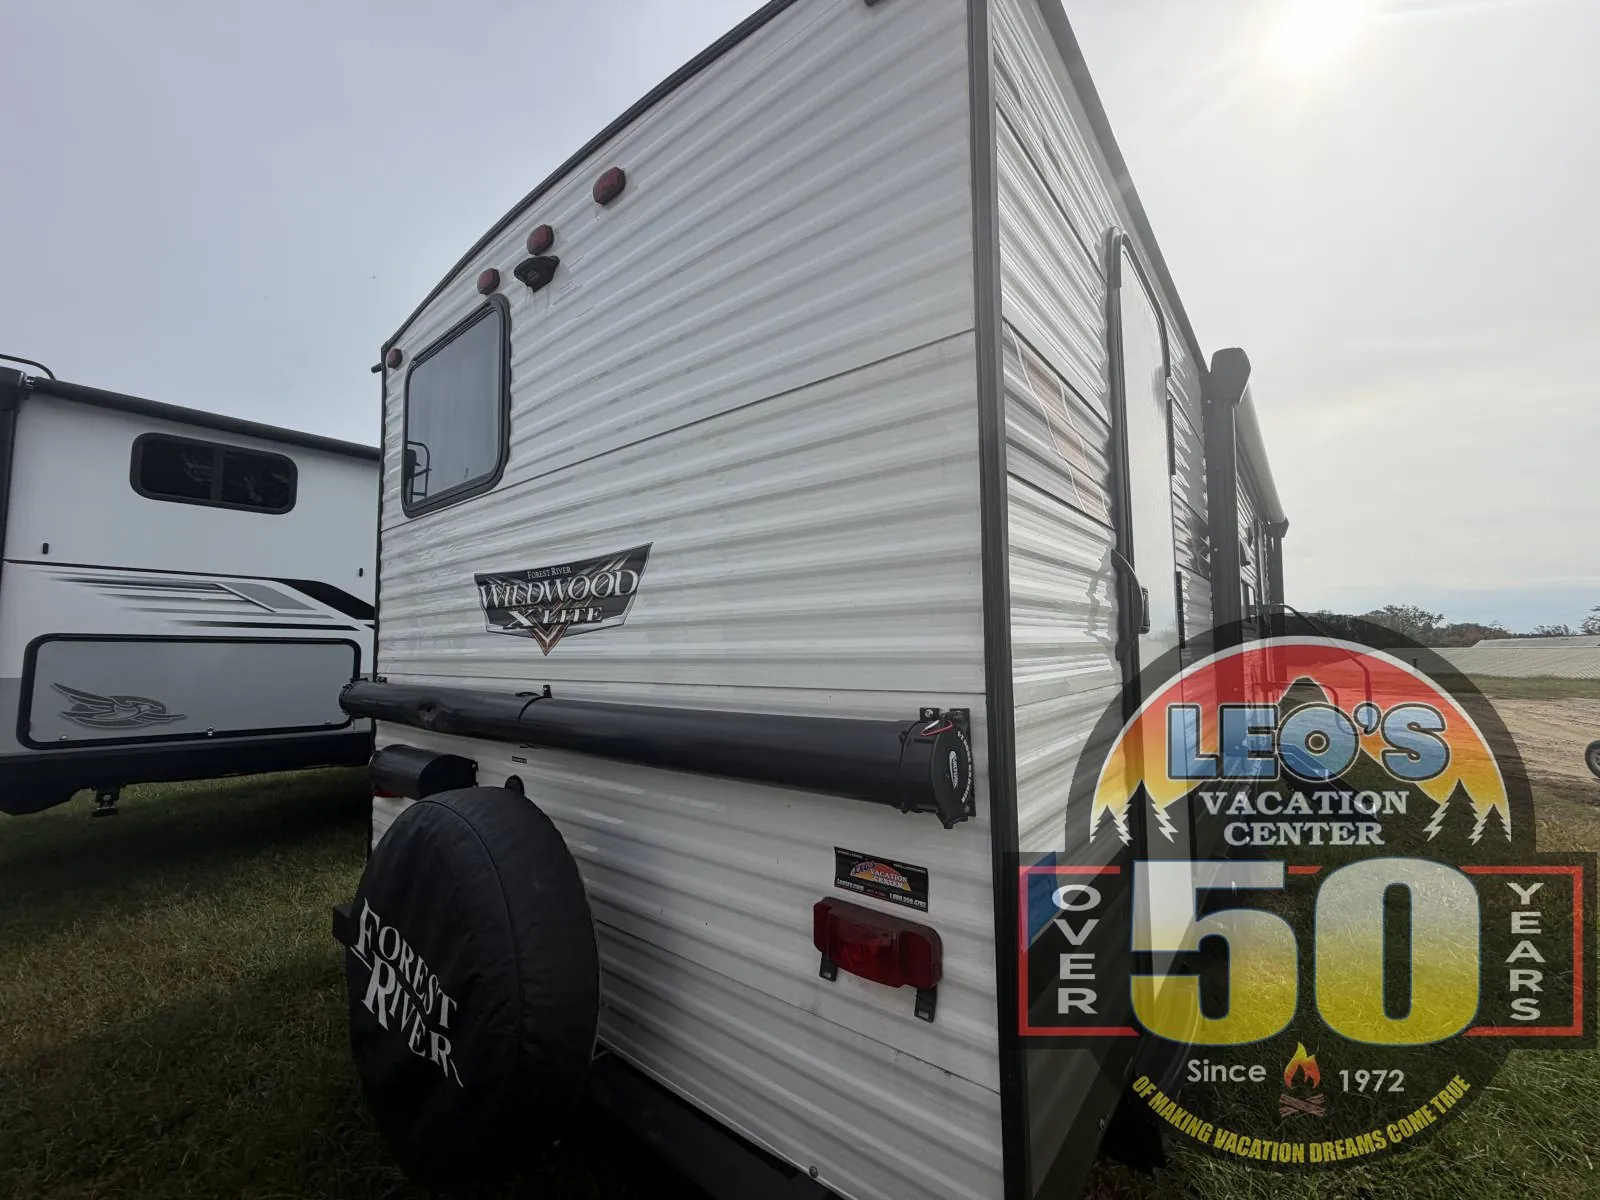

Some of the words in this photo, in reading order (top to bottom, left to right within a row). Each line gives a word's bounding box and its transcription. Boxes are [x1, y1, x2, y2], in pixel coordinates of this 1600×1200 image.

[479, 569, 639, 609] WILDWOOD
[527, 569, 550, 580] FOREST
[550, 566, 572, 577] RIVER
[354, 897, 458, 1029] FOREST
[361, 950, 453, 1079] RIVER
